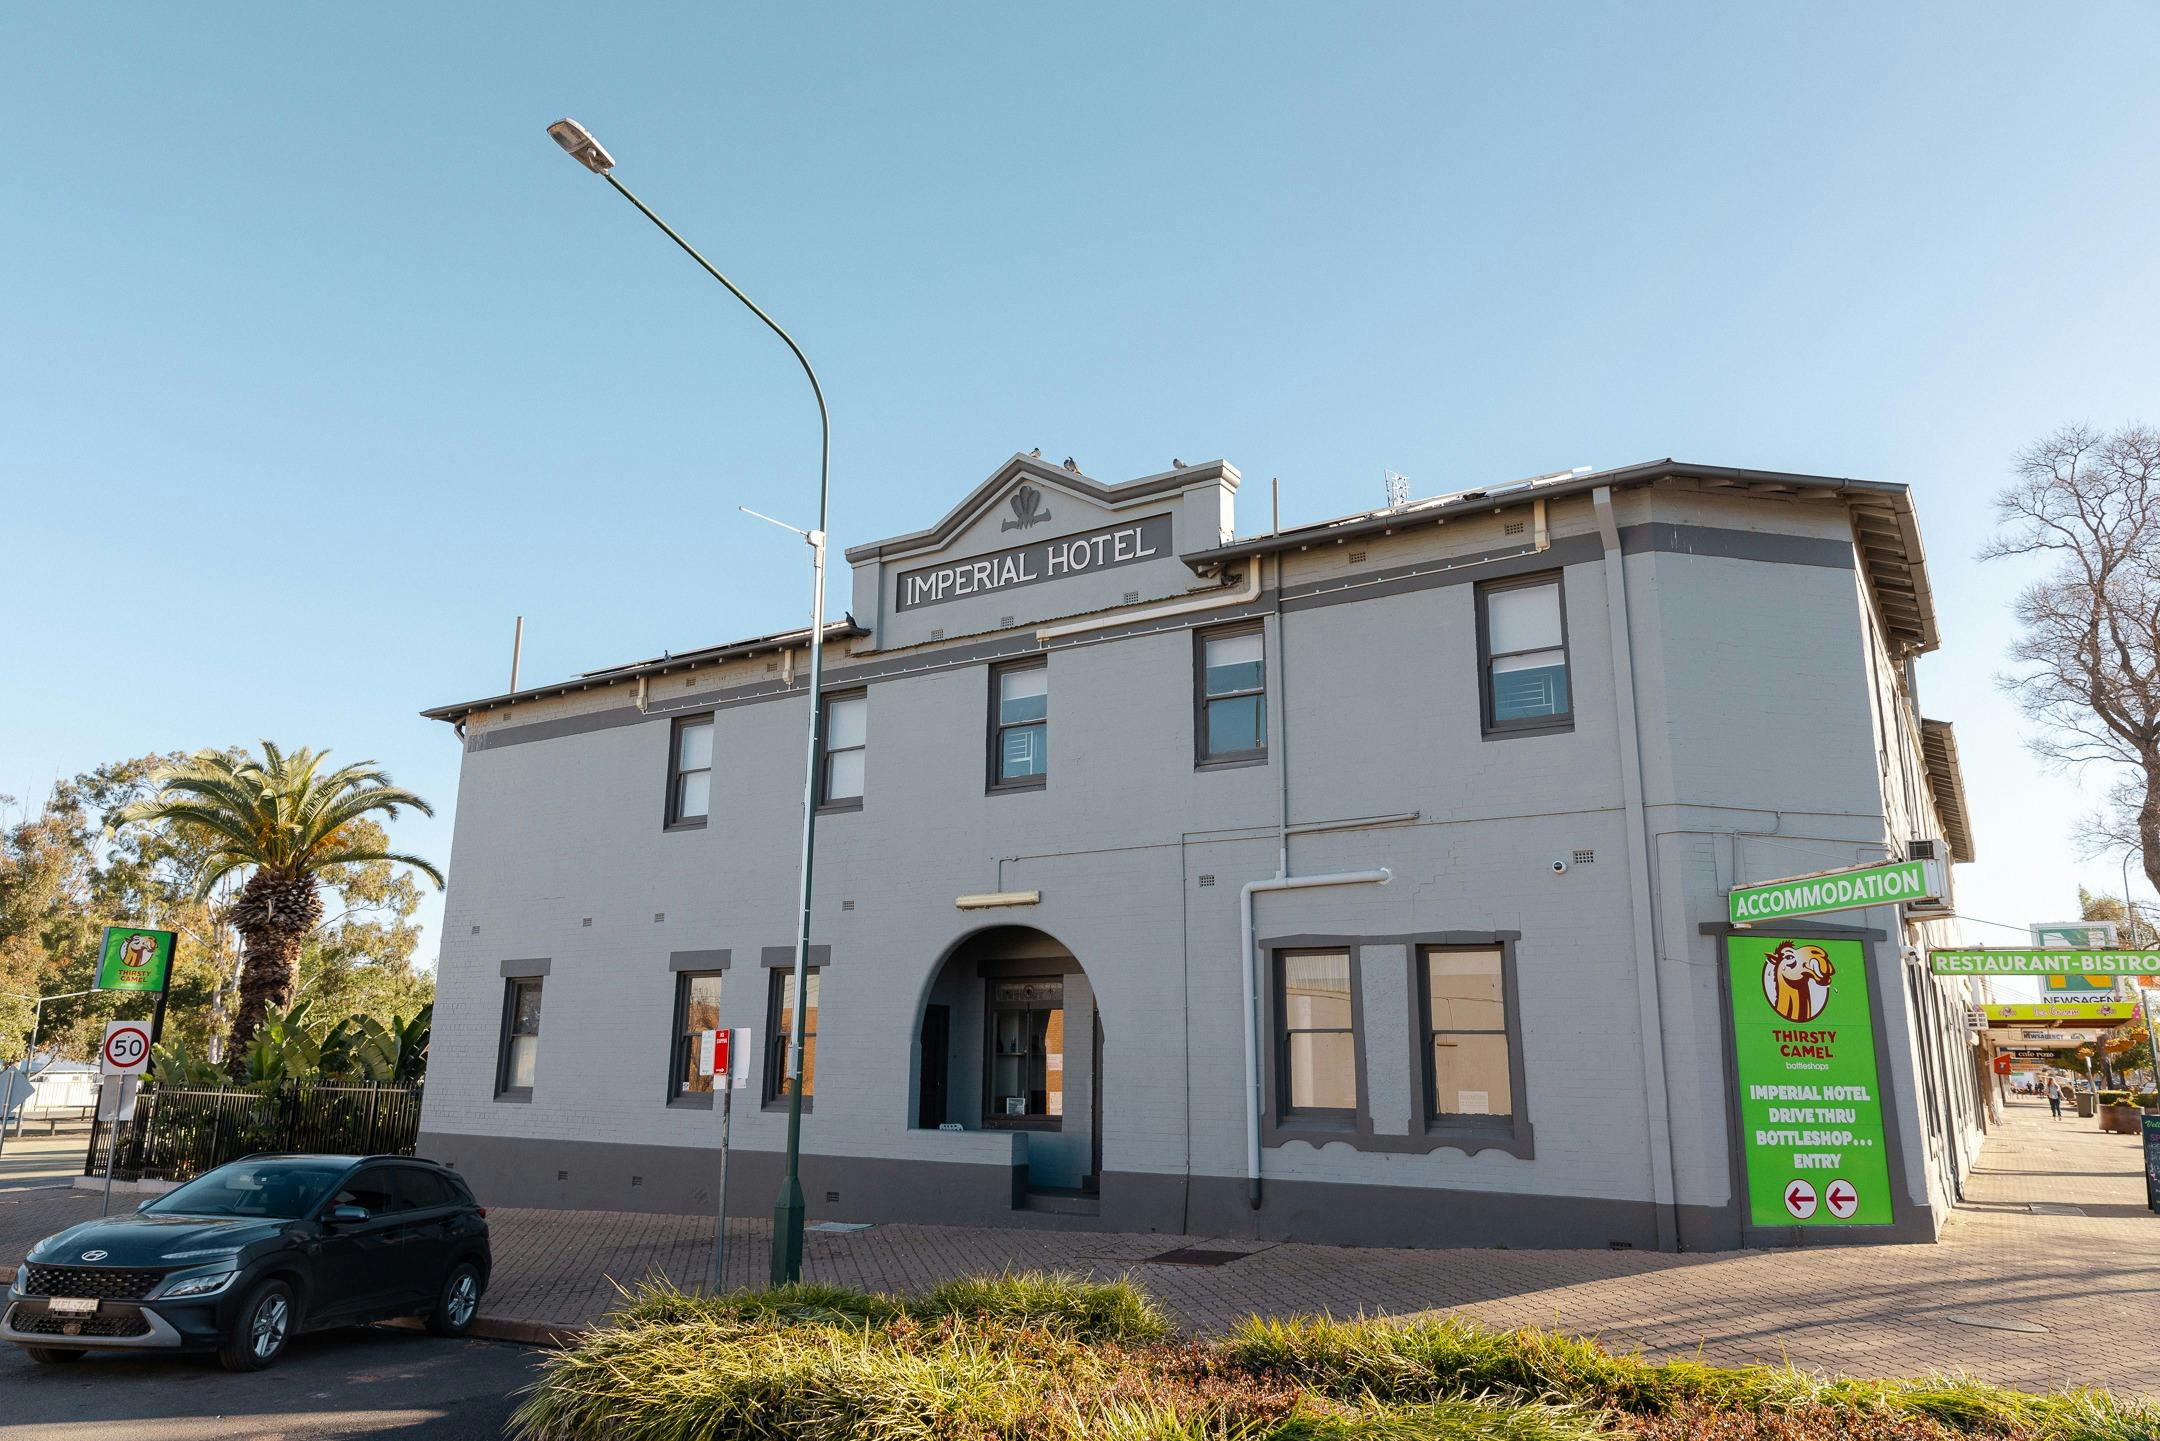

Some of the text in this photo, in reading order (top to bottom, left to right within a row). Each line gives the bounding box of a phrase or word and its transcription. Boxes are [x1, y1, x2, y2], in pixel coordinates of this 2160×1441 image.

[905, 527, 1157, 606] IMPERIAL HOTEL
[1736, 868, 1920, 917] ACCOMMODATION
[1935, 955, 2160, 971] RESTAURANT-BISTRO
[1772, 1030, 1837, 1044] THIRSTY
[113, 1039, 142, 1057] 50
[1780, 1044, 1834, 1059] CAMEL
[1785, 1061, 1829, 1071] bottleshops
[1749, 1085, 1871, 1101] IMPERIAL HOTEL
[1768, 1107, 1856, 1124] DRIVE THRU
[1755, 1130, 1873, 1146] BOTTLESHOP...
[1793, 1153, 1842, 1169] ENTRY
